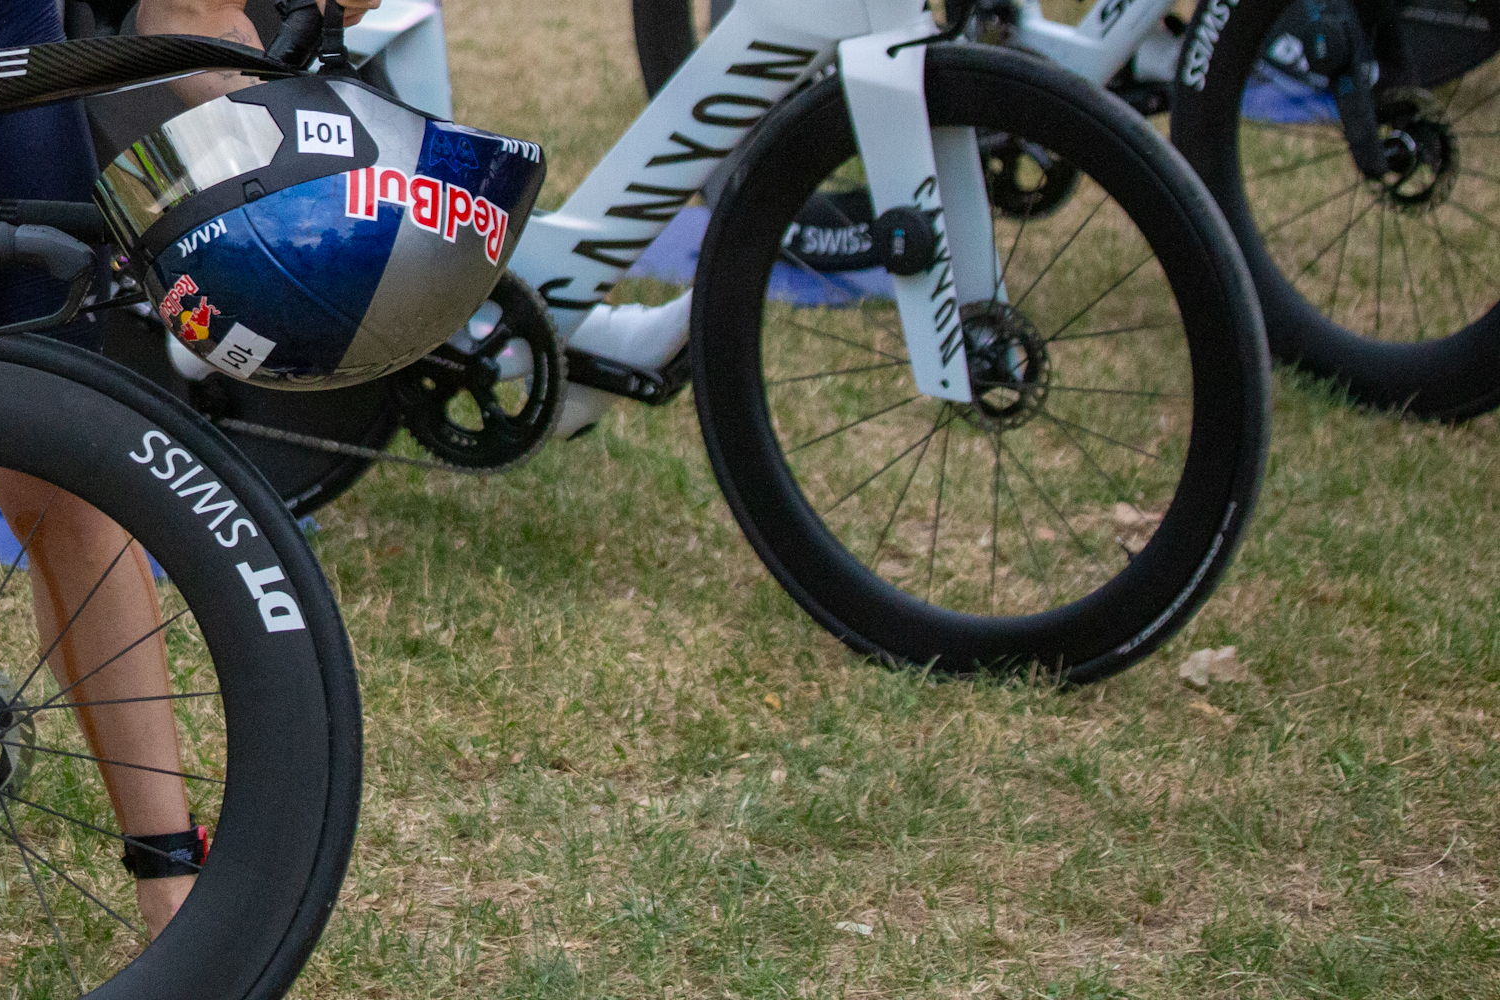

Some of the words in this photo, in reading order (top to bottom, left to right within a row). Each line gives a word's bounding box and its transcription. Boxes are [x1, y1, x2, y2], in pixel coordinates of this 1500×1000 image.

[303, 121, 348, 145] 101
[176, 218, 228, 258] KASK
[221, 343, 254, 370] 101
[129, 429, 259, 548] SWISS
[235, 561, 306, 633] DT
